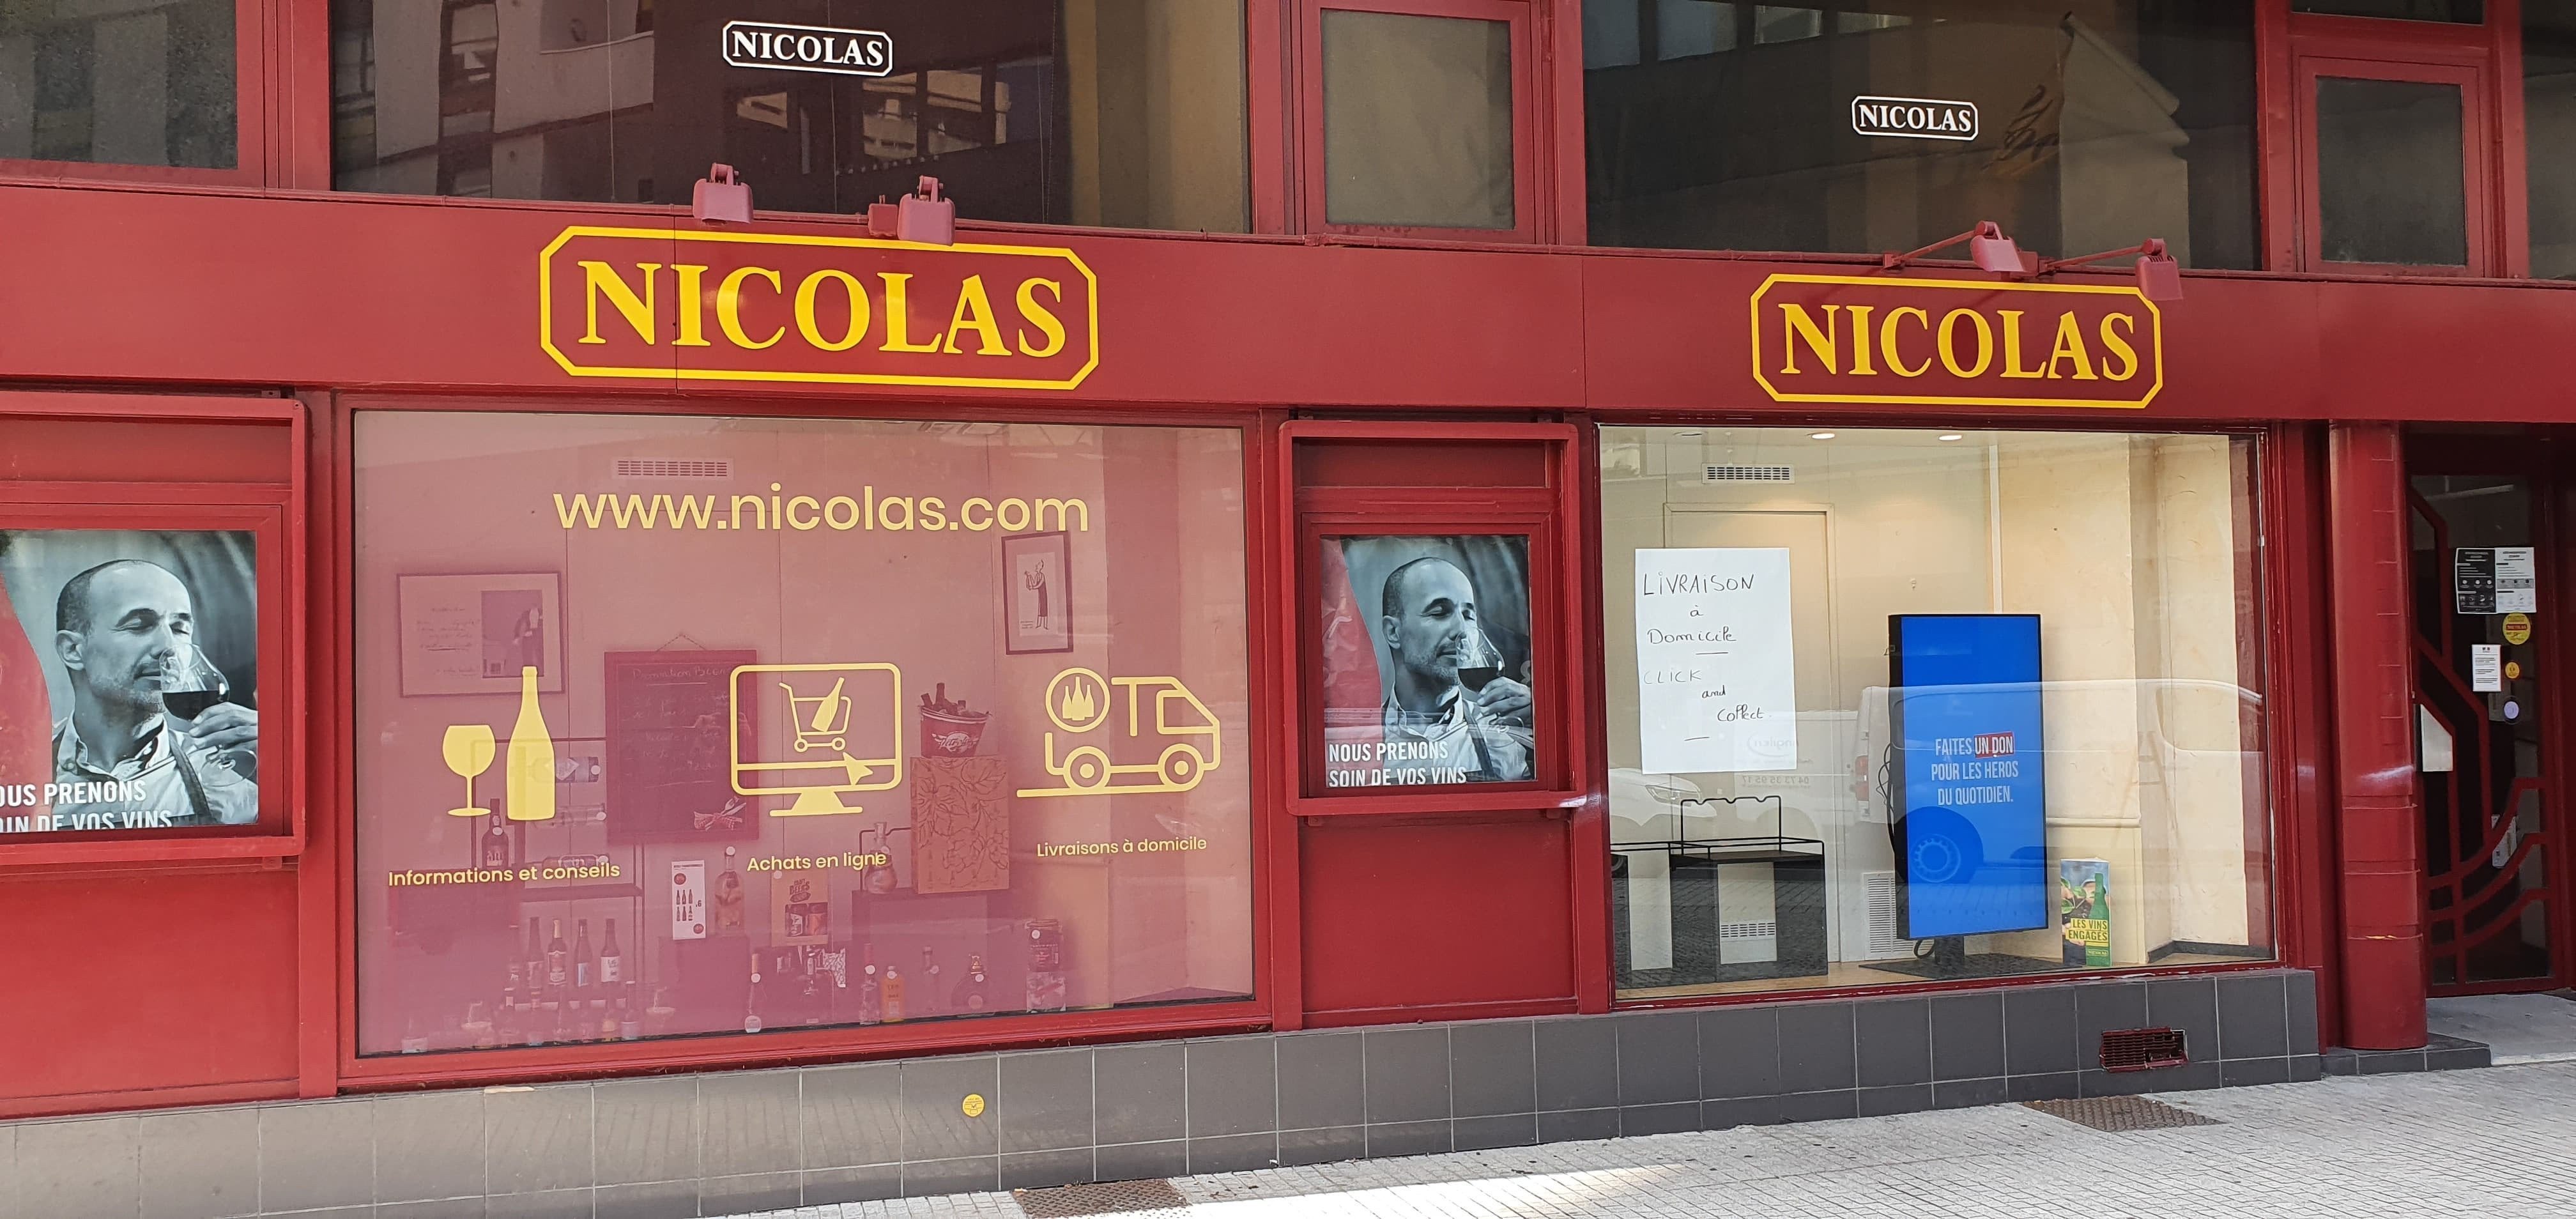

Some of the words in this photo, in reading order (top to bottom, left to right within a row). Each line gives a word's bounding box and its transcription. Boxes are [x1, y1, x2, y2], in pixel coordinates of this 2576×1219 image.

[732, 31, 884, 66] NICOLAS
[1858, 104, 1972, 132] NICOLAS
[577, 261, 1067, 358] NICOLAS
[1778, 303, 2138, 381] NICOLAS
[553, 482, 1089, 533] www.nicolas.com
[1690, 604, 1704, 617] à
[1647, 625, 1737, 644] Domicile
[1643, 668, 1703, 684] CLICK
[1701, 685, 1726, 698] and
[1717, 704, 1765, 722] Collect
[1328, 743, 1372, 762] NOUS
[1376, 740, 1448, 761] PRENONS
[1935, 737, 1973, 756] FAITES
[1974, 737, 1989, 755] UN
[1992, 736, 2013, 754] DON
[1328, 769, 1366, 788] SOIN
[1371, 769, 1392, 786] DE
[1397, 767, 1426, 785] VOS
[1430, 766, 1468, 785] VINS
[1931, 763, 1960, 781] POUR
[1962, 762, 1982, 780] LES
[44, 780, 147, 806] PRENONS
[1938, 788, 1952, 806] DU
[1955, 786, 2014, 806] QUOTIDIEN.
[37, 815, 63, 832] DE
[72, 813, 116, 830] VOS
[121, 810, 172, 829] VINS
[1037, 840, 1119, 857] Livraisons
[1123, 839, 1133, 853] à
[1137, 836, 1207, 852] domicile
[747, 855, 811, 871] Achats
[816, 855, 839, 868] en
[843, 851, 887, 871] ligne
[388, 867, 514, 887] Informations
[519, 866, 538, 881] et
[542, 862, 620, 880] conseils
[2072, 919, 2087, 929] LES
[2089, 919, 2108, 930] VINS
